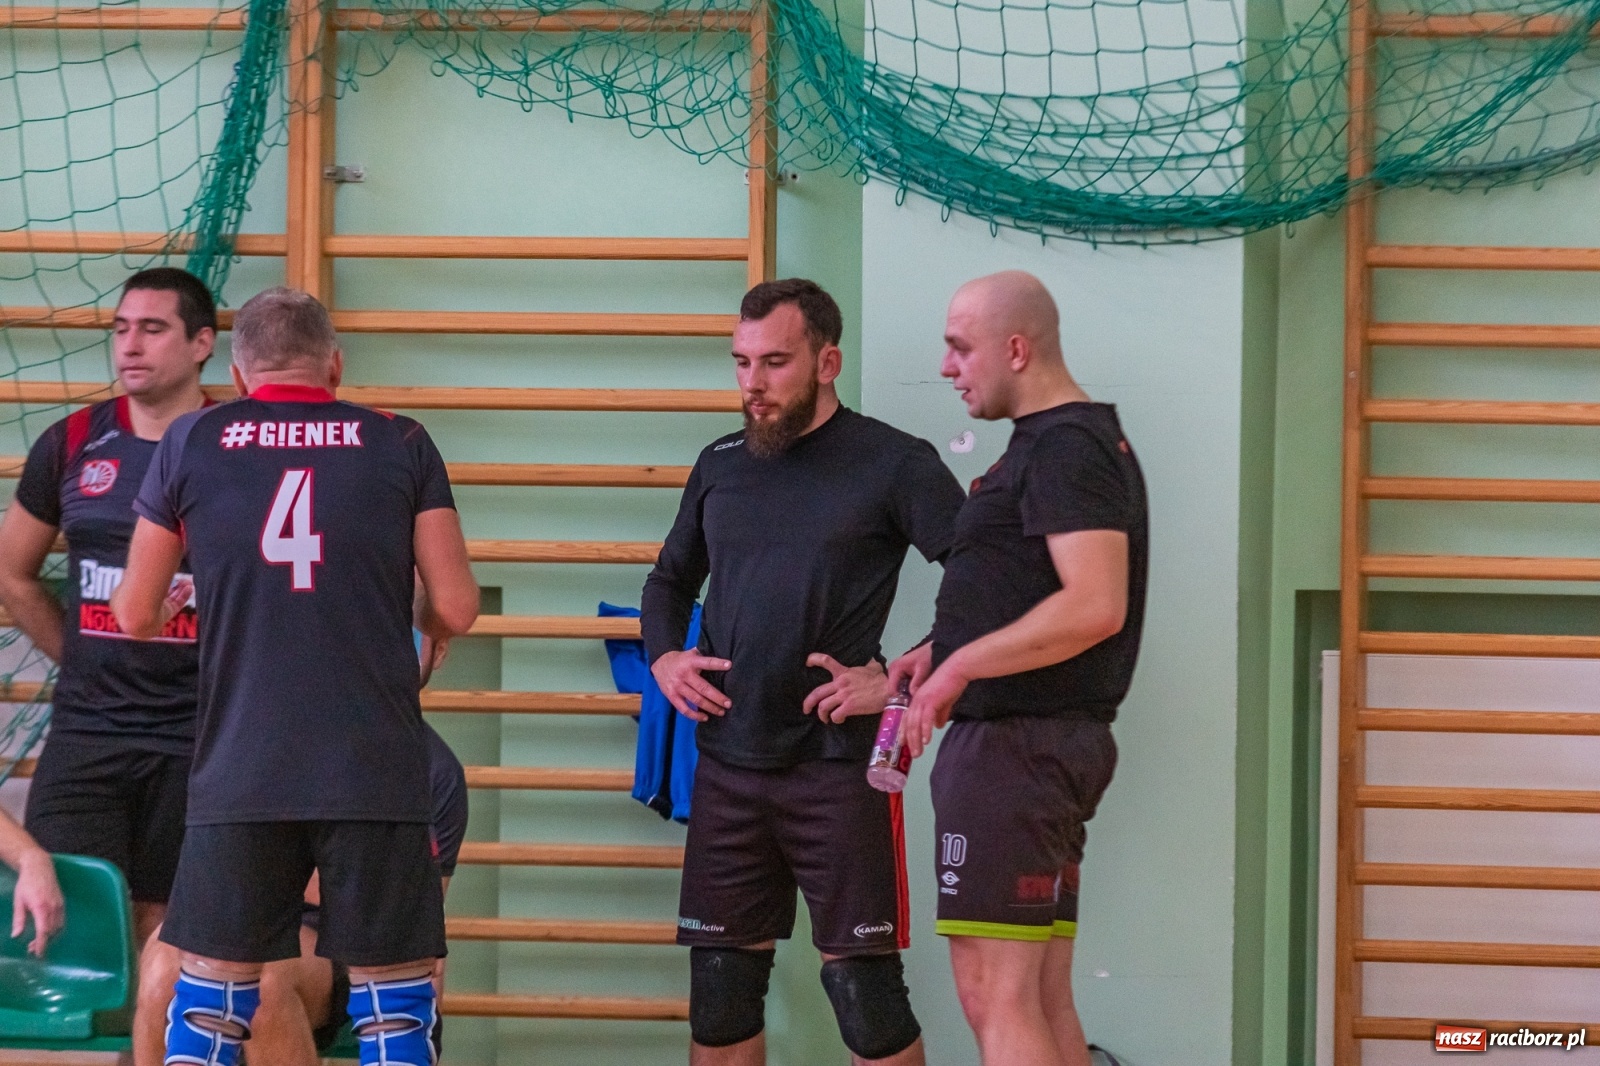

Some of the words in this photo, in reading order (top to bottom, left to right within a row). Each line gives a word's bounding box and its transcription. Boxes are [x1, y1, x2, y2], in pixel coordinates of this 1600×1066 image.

[259, 467, 324, 592] 4
[942, 832, 967, 866] 10
[701, 924, 725, 933] Active
[857, 924, 891, 935] KAMAN
